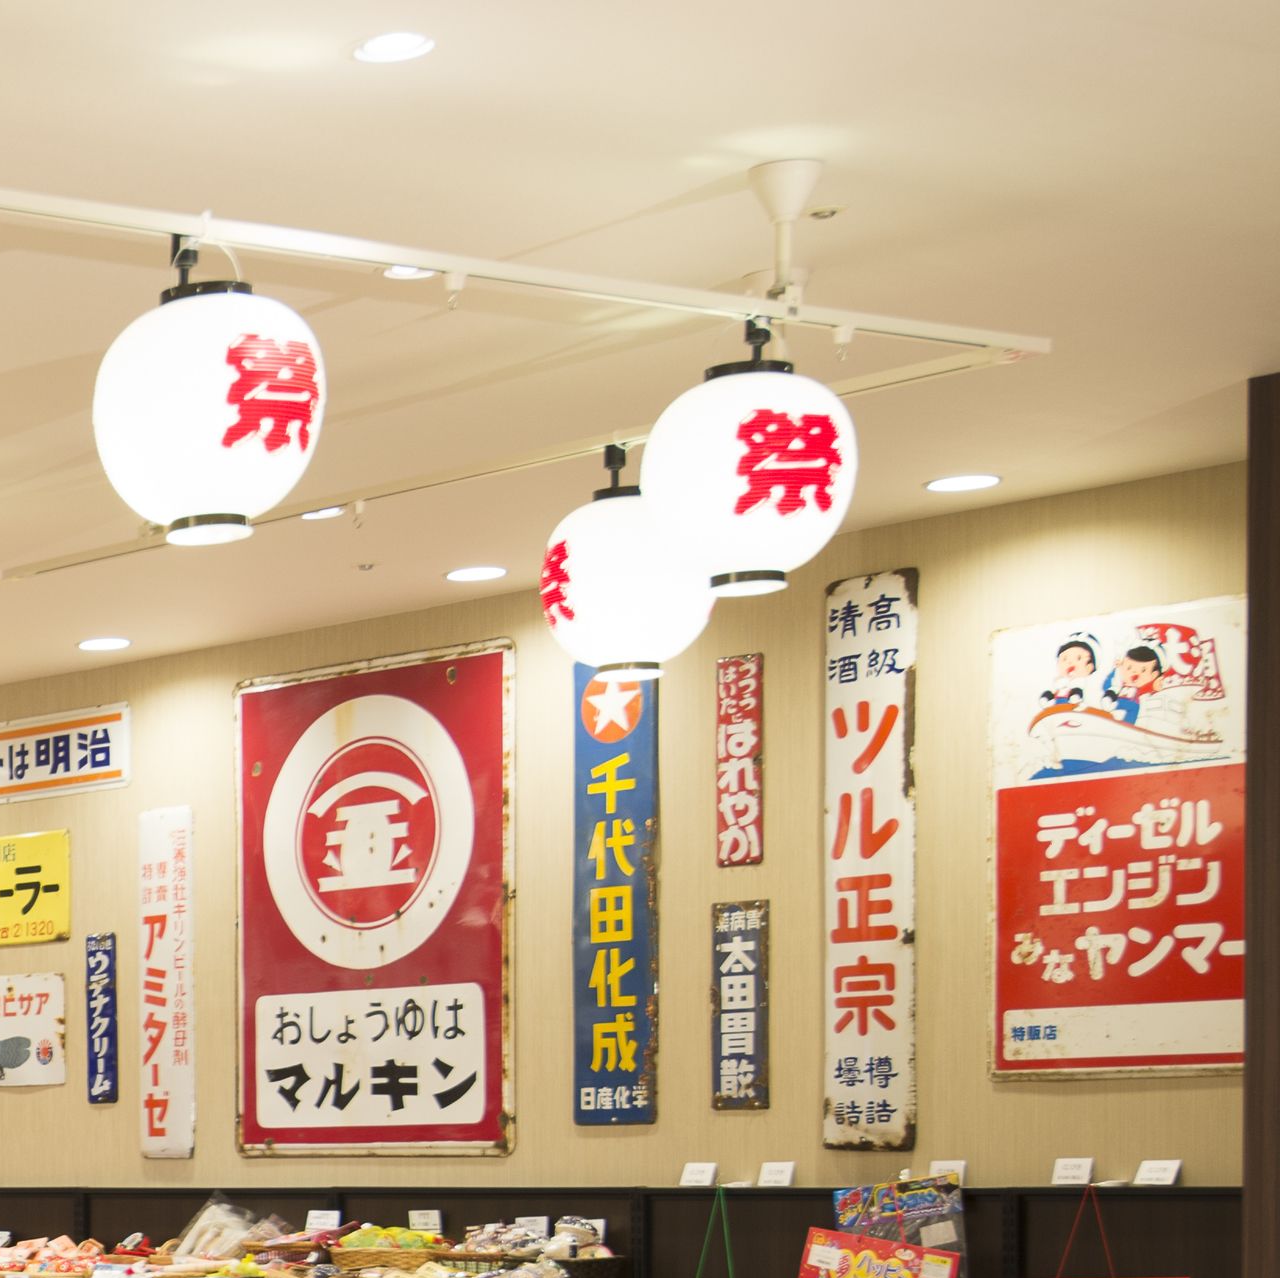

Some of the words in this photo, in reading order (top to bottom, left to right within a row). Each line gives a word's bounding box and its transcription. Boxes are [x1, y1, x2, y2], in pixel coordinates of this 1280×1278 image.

[222, 335, 319, 453] 祭
[735, 409, 842, 516] 祭
[828, 600, 863, 684] 清酒
[866, 593, 905, 678] 高級
[717, 719, 761, 863] はれやか
[1036, 797, 1223, 860] ディーゼル
[830, 700, 900, 1037] ツル正宗
[1038, 854, 1221, 917] エンジン
[587, 752, 638, 1075] 千代田化成
[88, 951, 113, 1097] ウテナクリーム
[142, 913, 170, 1138] アミターゼ
[271, 996, 467, 1046] おしょうゆは
[1010, 1025, 1058, 1043] 特販店
[265, 1056, 478, 1112] マルキン
[580, 1084, 649, 1110] 日産化学
